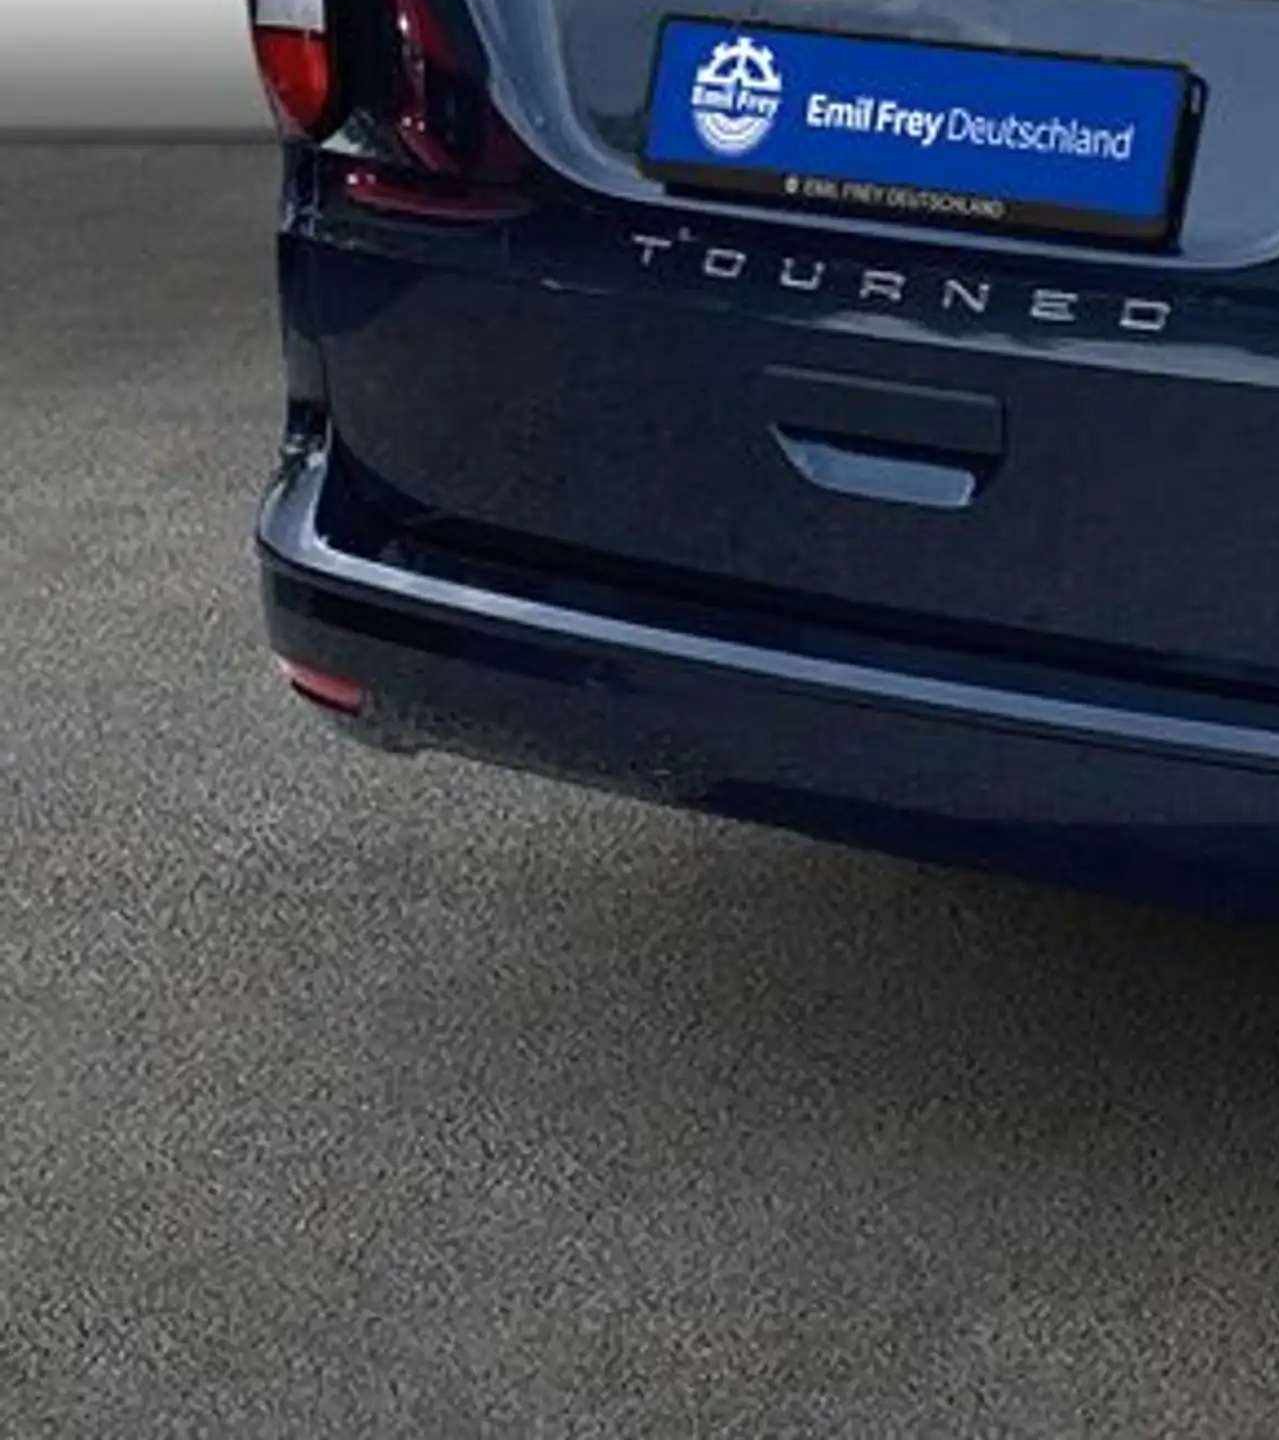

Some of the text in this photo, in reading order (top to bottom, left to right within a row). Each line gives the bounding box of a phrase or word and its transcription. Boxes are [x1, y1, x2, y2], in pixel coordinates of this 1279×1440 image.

[806, 94, 1135, 160] Emil Frey Deutschland
[632, 232, 1171, 331] TOURNEO
